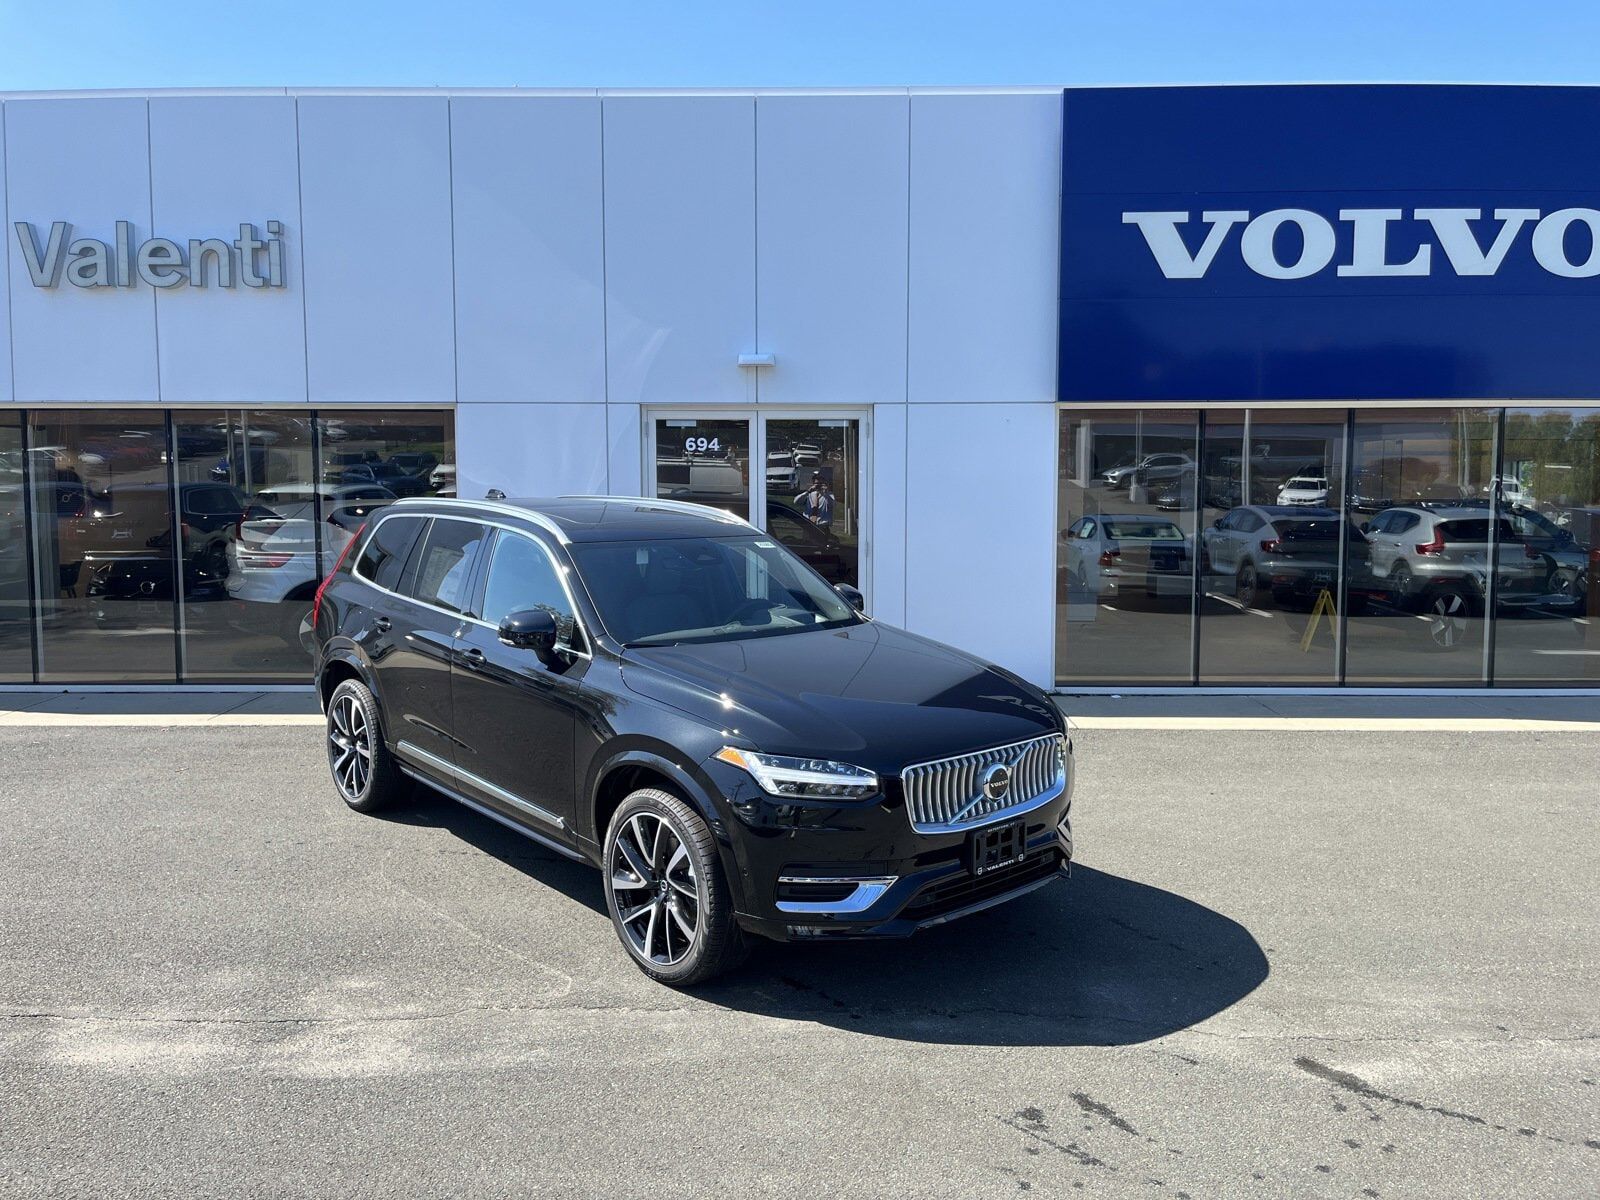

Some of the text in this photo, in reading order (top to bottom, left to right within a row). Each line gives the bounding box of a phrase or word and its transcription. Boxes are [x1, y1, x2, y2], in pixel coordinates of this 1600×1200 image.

[1122, 207, 1600, 280] VOLVO
[14, 220, 286, 288] Valenti
[685, 437, 720, 451] 694
[990, 779, 1008, 788] VOLVO
[986, 859, 1014, 871] VALENTI
